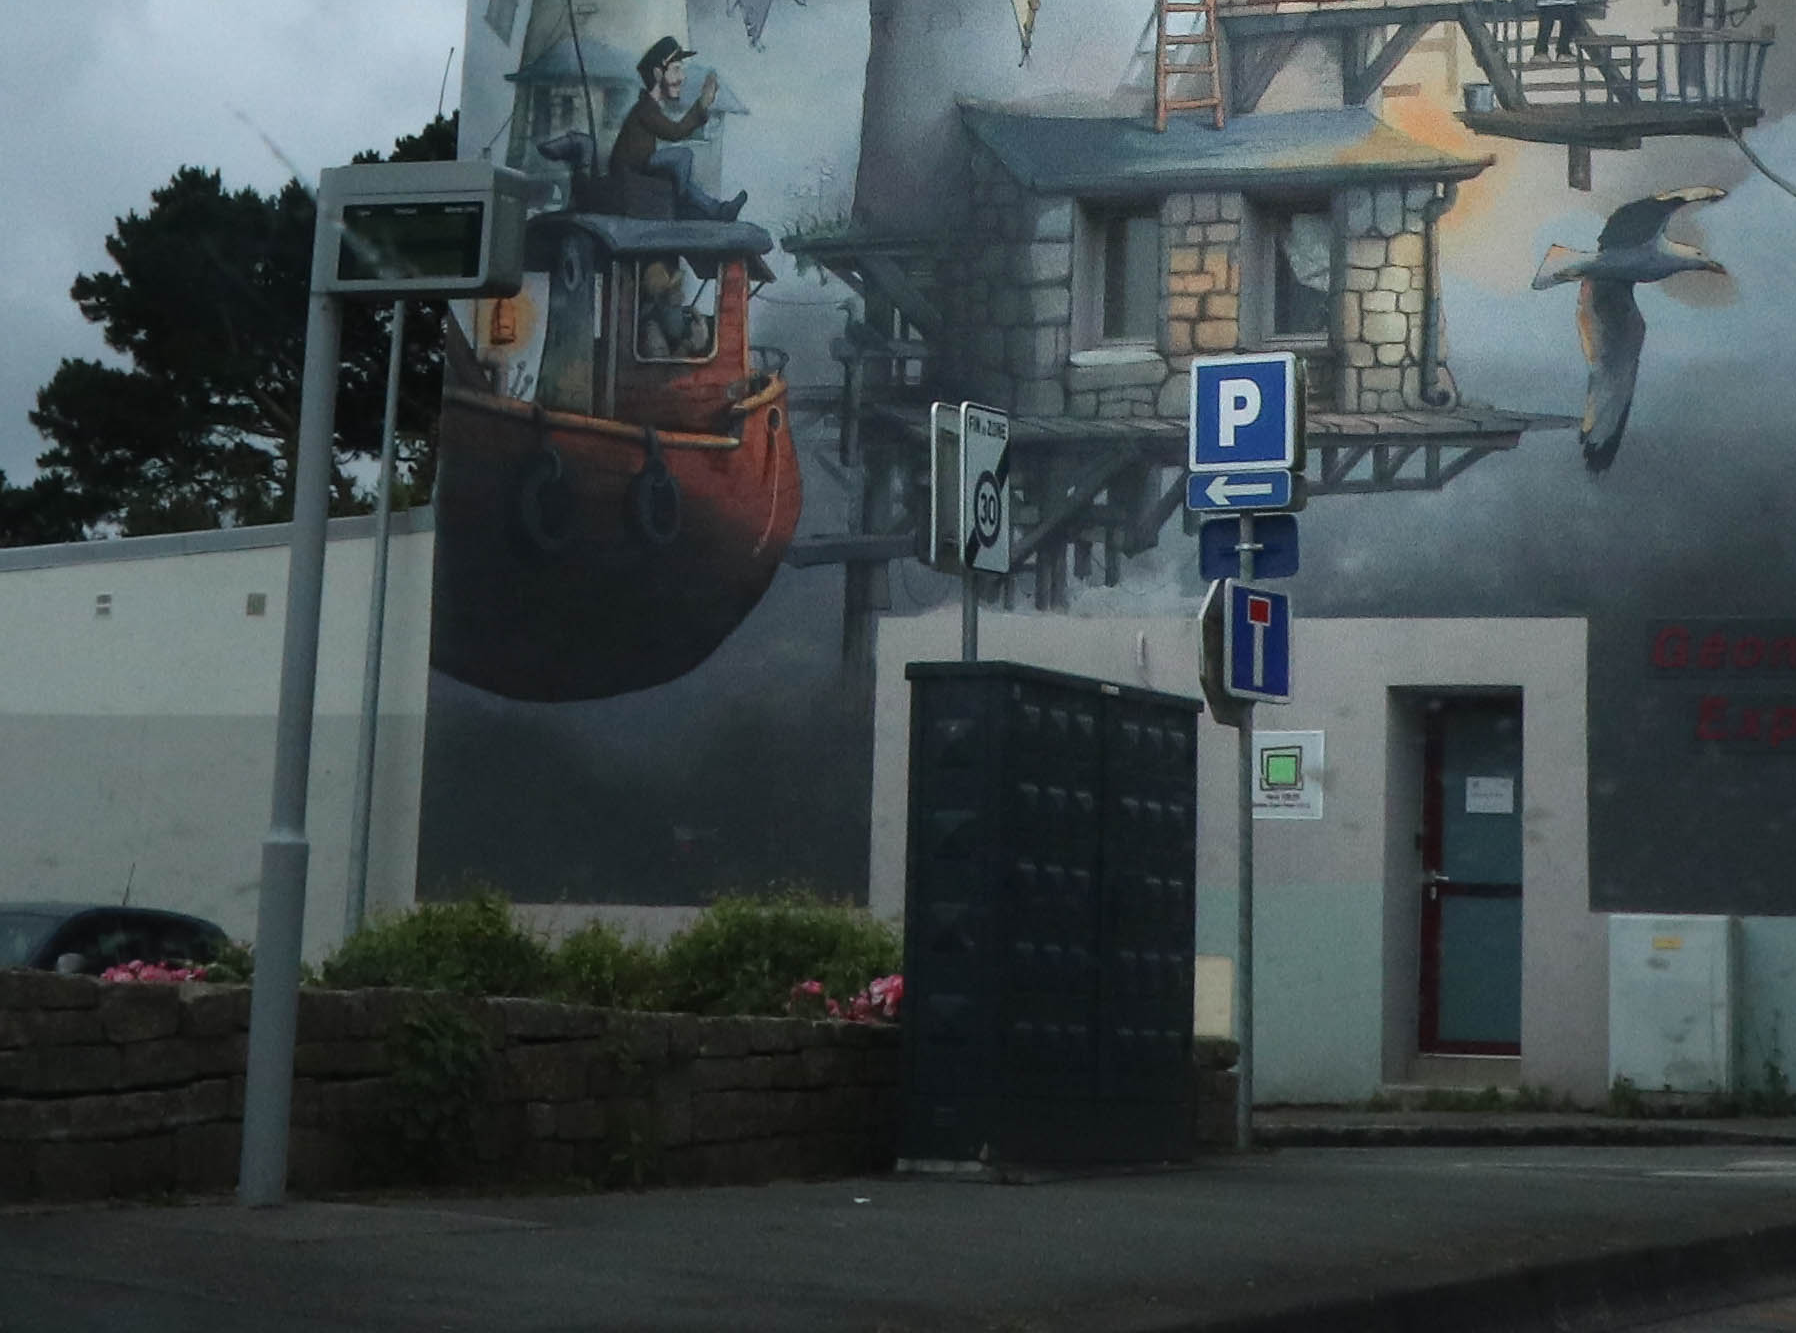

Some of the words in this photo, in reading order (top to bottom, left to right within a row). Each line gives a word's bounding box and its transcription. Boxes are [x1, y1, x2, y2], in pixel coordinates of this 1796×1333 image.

[968, 415, 981, 434] FIN
[986, 419, 1007, 440] ZONE
[1218, 378, 1262, 447] P
[979, 493, 996, 526] 30
